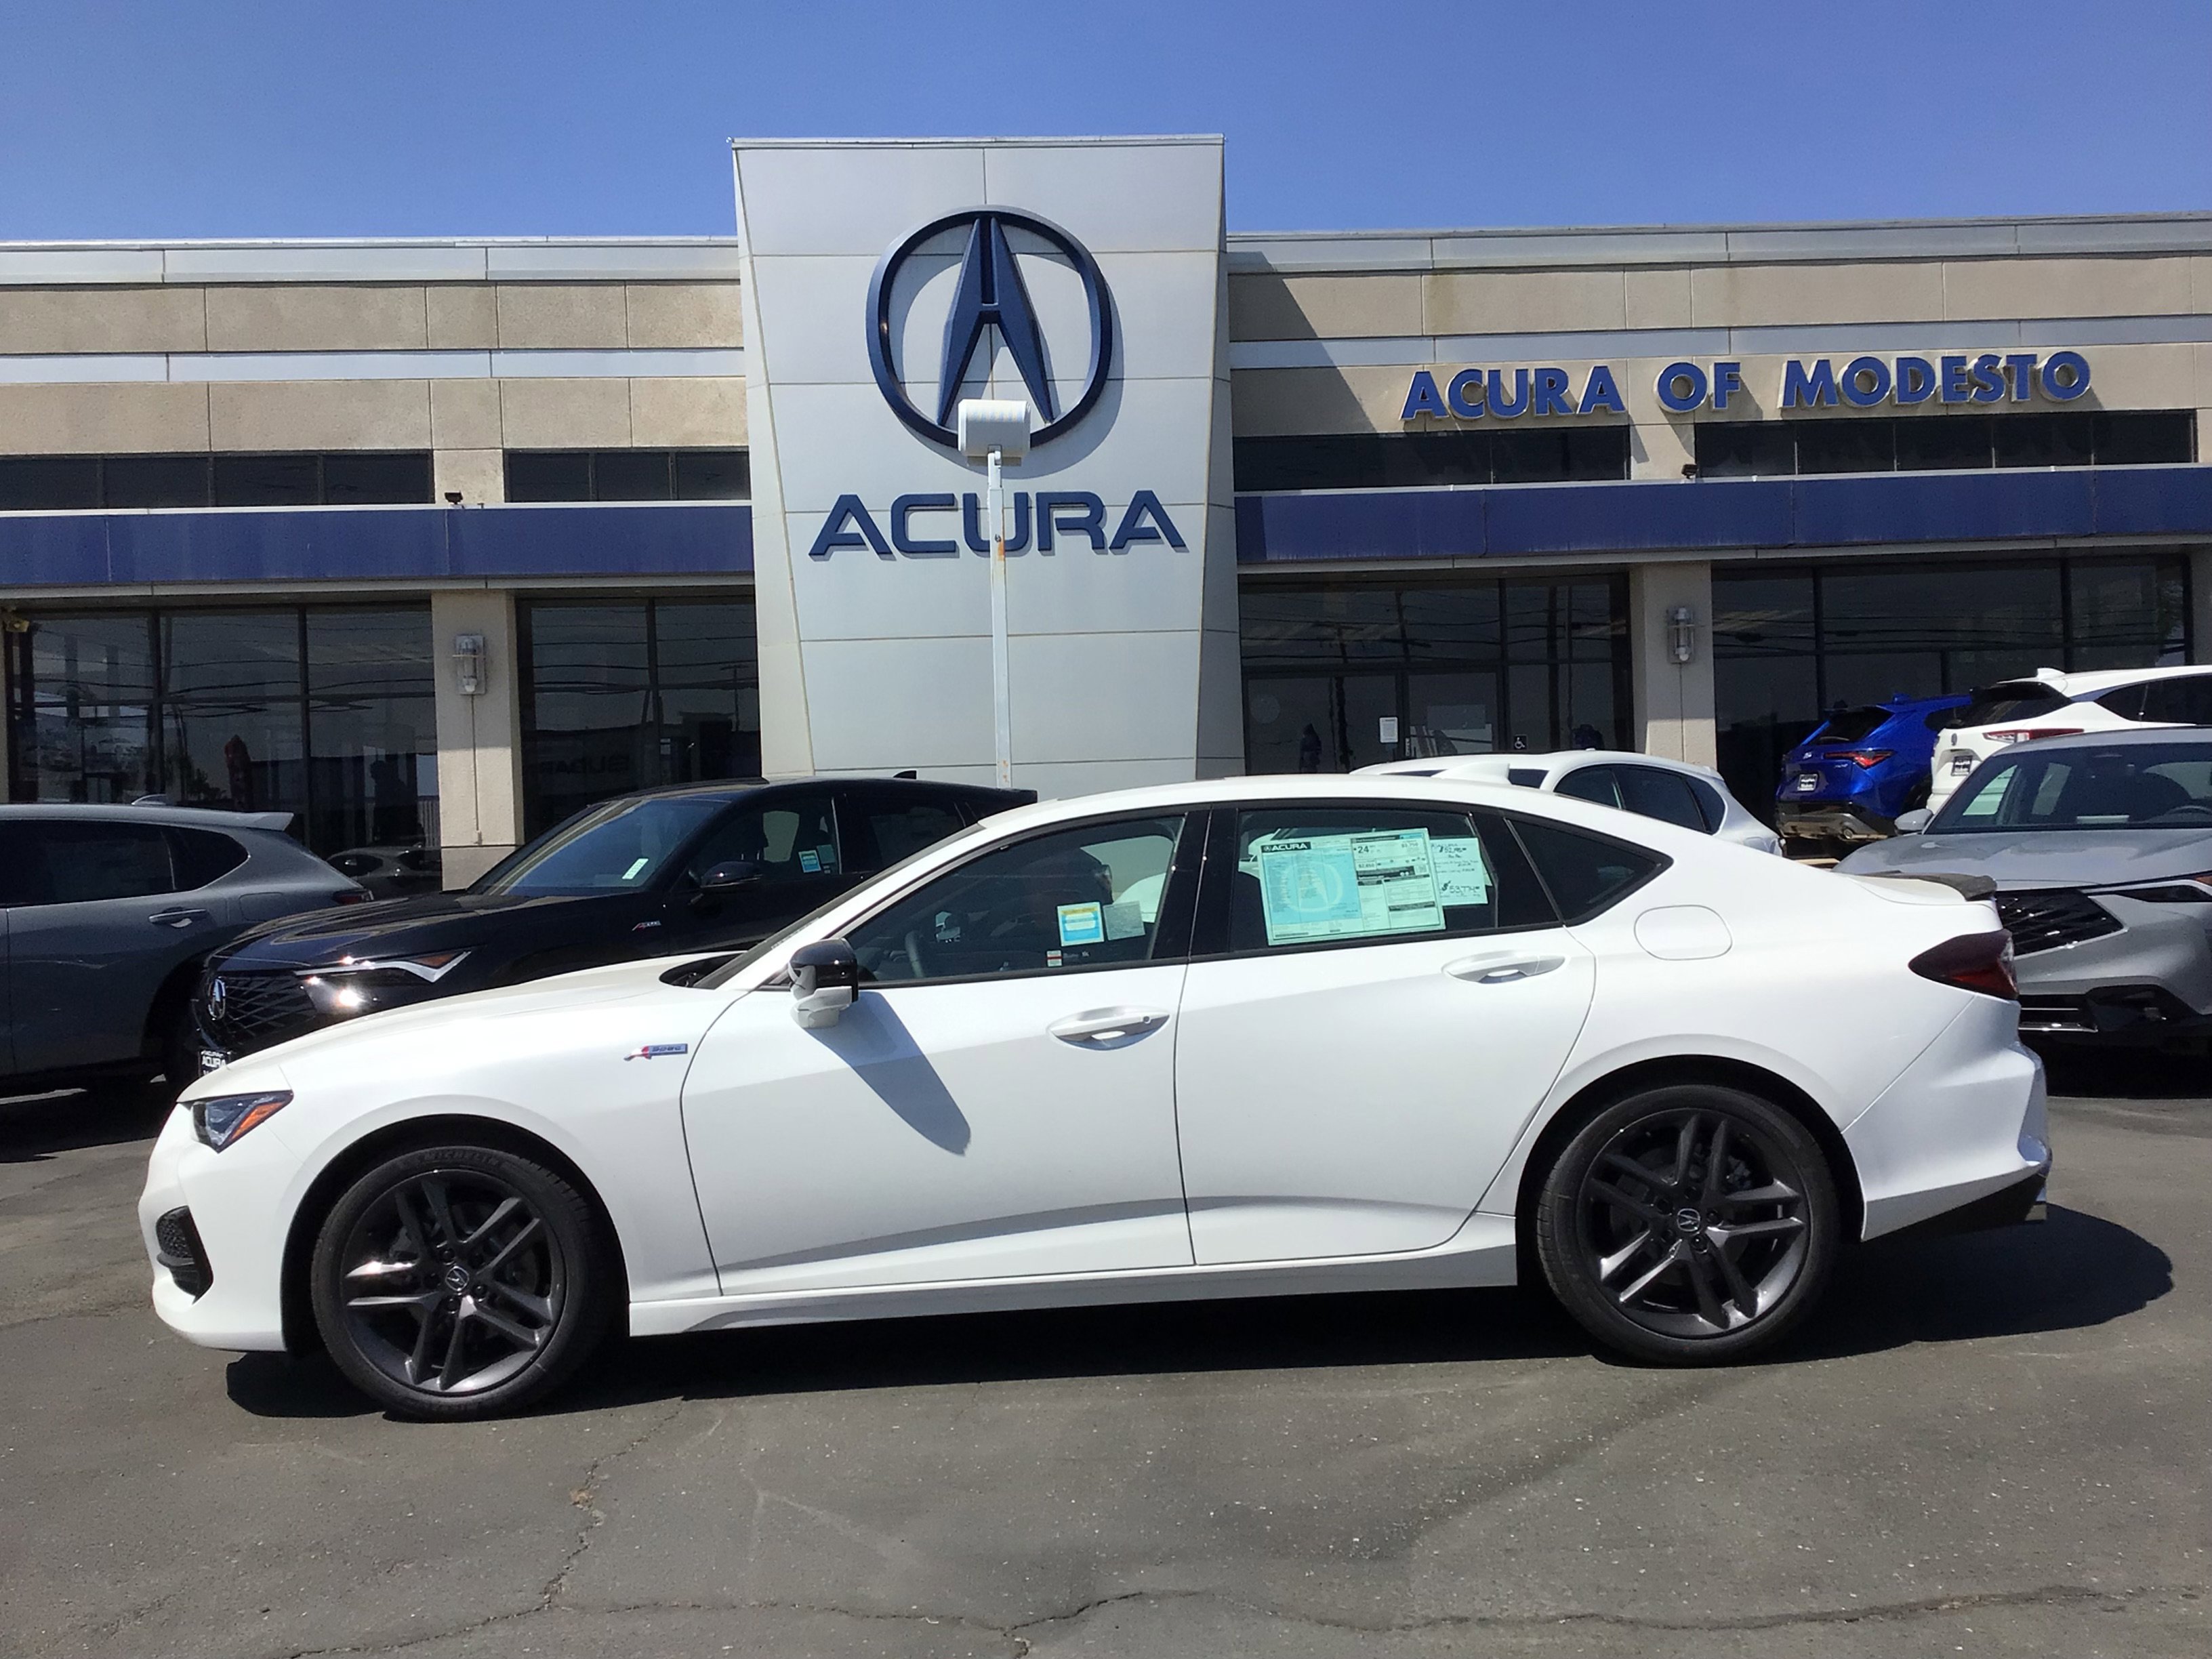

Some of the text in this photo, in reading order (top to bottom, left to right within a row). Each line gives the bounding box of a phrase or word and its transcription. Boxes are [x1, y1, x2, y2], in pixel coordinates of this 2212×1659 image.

[1399, 351, 2091, 420] ACURA OF MODESTO
[808, 490, 1187, 558] ACURA
[1271, 843, 1308, 852] ACURA
[1357, 845, 1369, 854] 24
